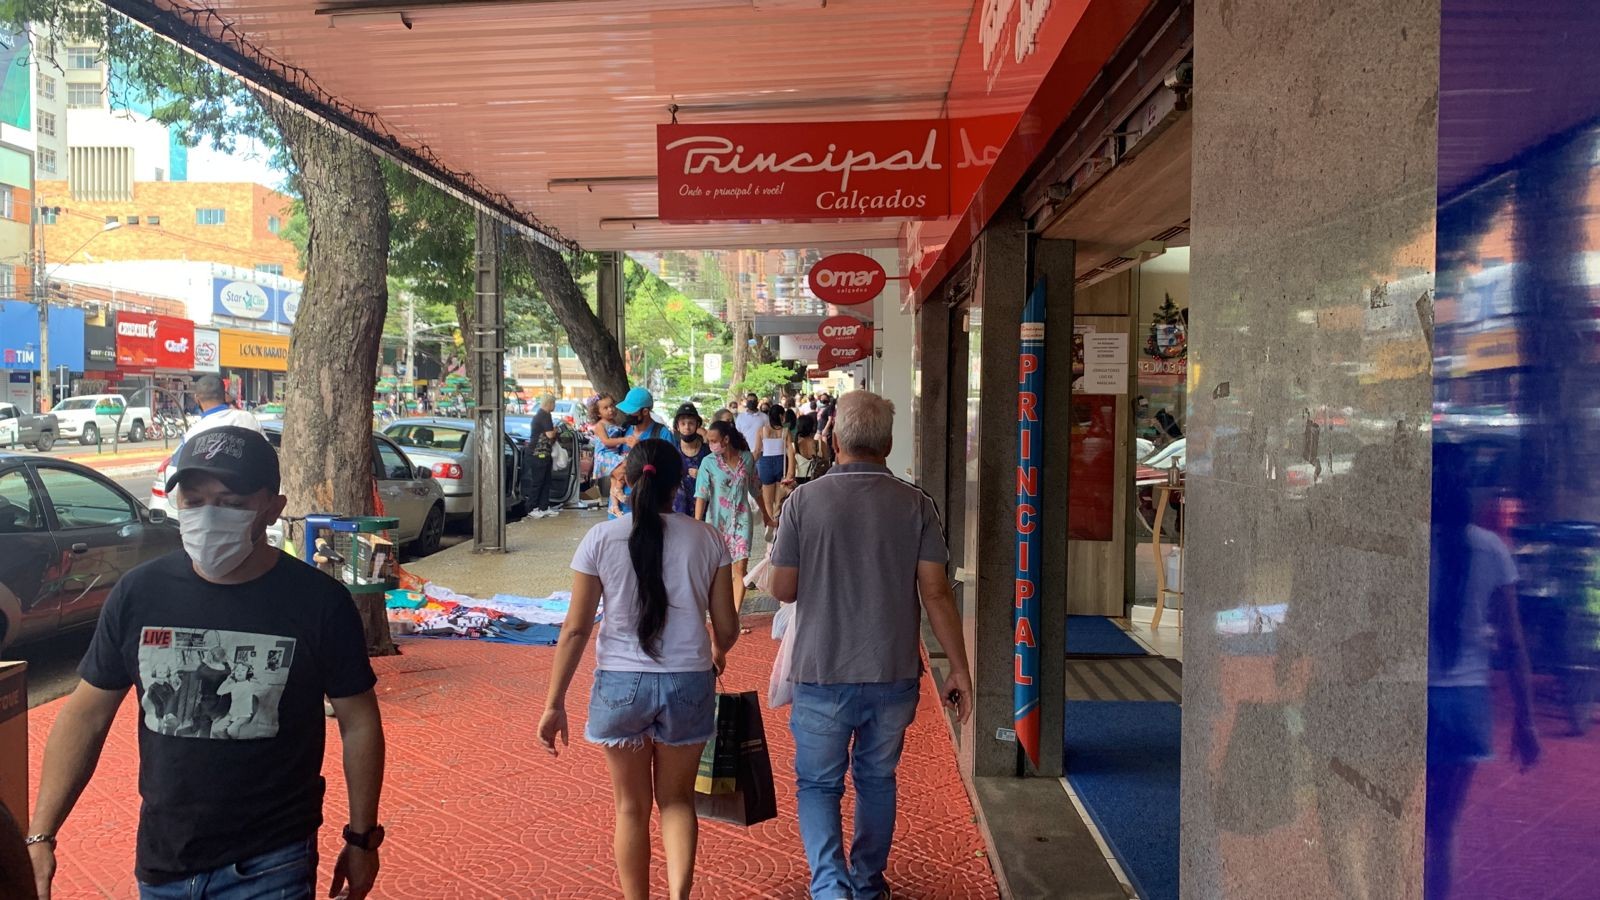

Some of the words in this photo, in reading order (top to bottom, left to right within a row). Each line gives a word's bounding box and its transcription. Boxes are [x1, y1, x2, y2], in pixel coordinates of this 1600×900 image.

[665, 129, 943, 192] Principal
[679, 184, 702, 196] Onde
[713, 183, 752, 199] principal
[754, 185, 760, 195] é
[763, 181, 785, 195] você!
[816, 190, 927, 213] Calçados
[226, 291, 242, 303] Star
[16, 350, 35, 364] TIM
[1014, 353, 1039, 686] PRINCIPAL
[143, 630, 171, 645] LIVE
